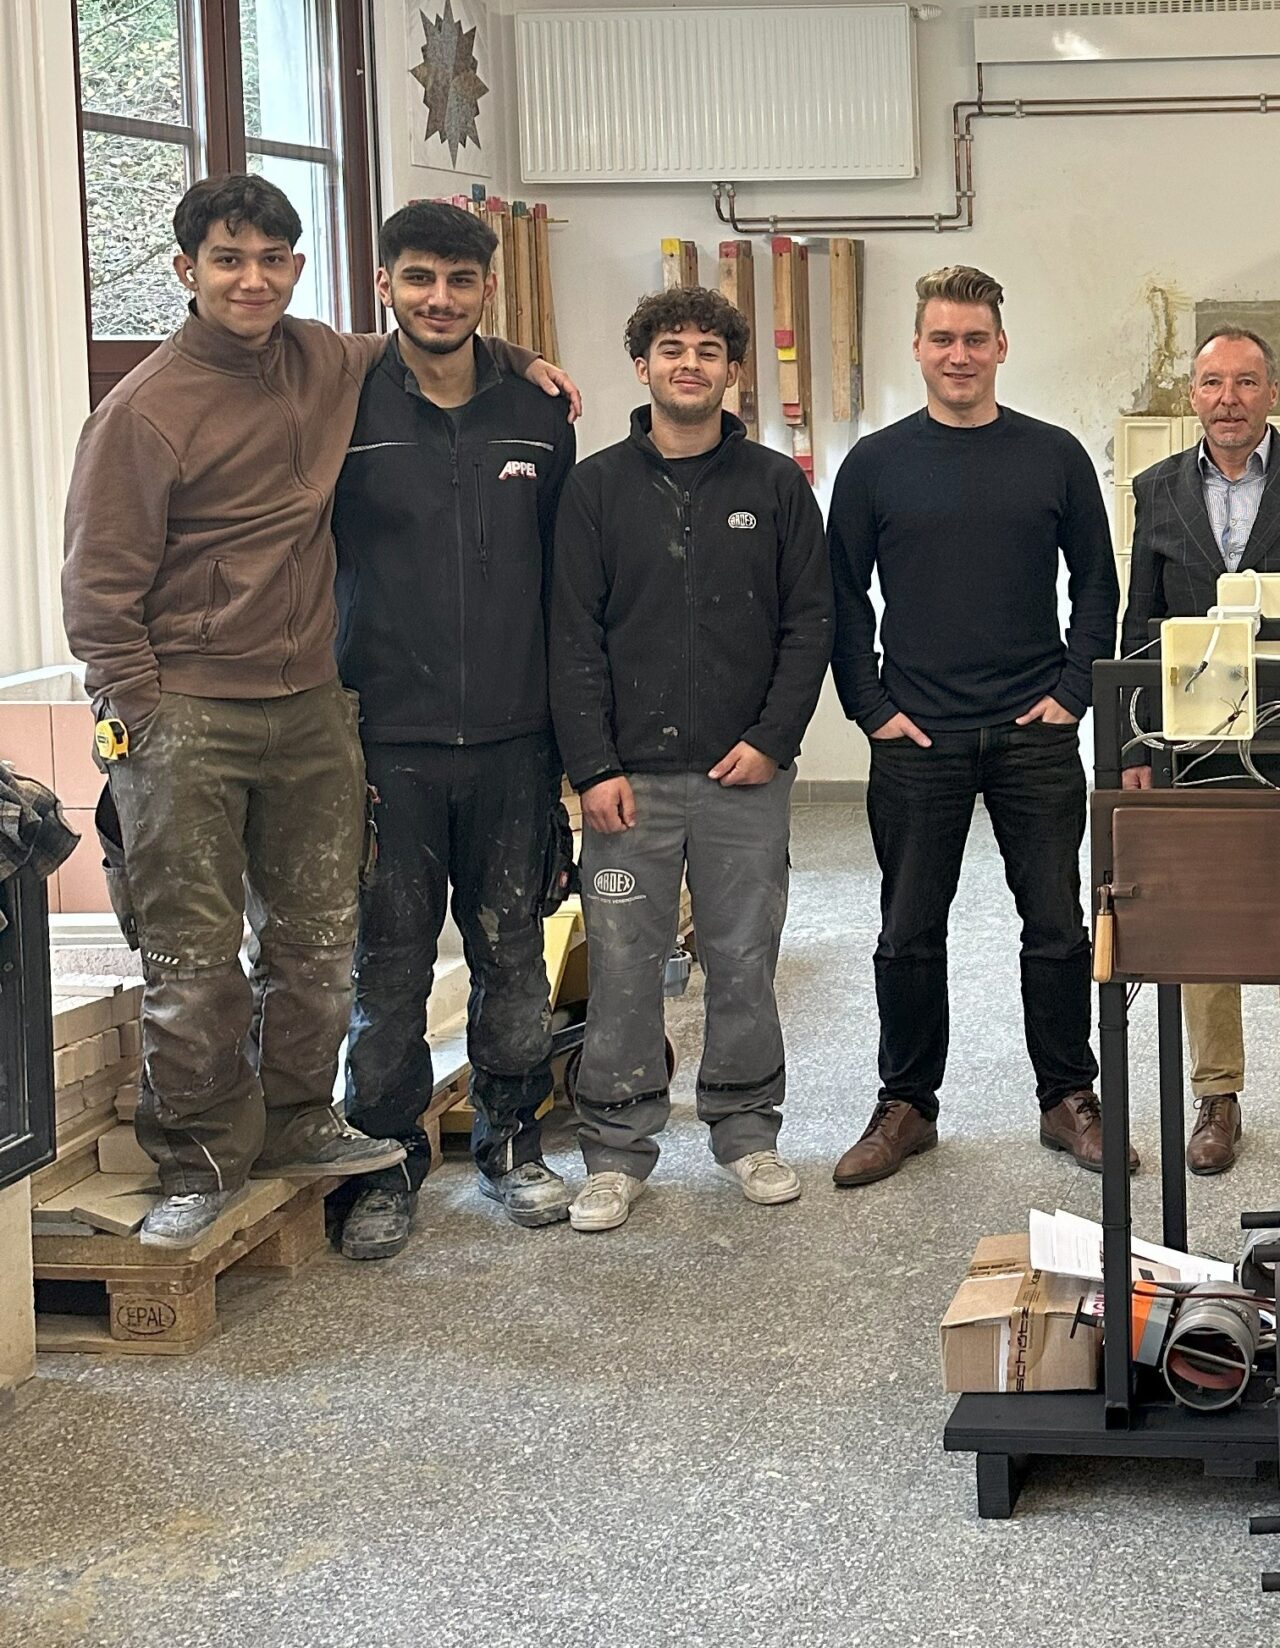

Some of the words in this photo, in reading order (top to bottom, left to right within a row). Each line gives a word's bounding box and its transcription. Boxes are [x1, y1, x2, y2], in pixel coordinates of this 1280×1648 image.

[498, 460, 537, 480] APPEL
[597, 872, 631, 893] ARDEX
[126, 1306, 170, 1328] EPAL
